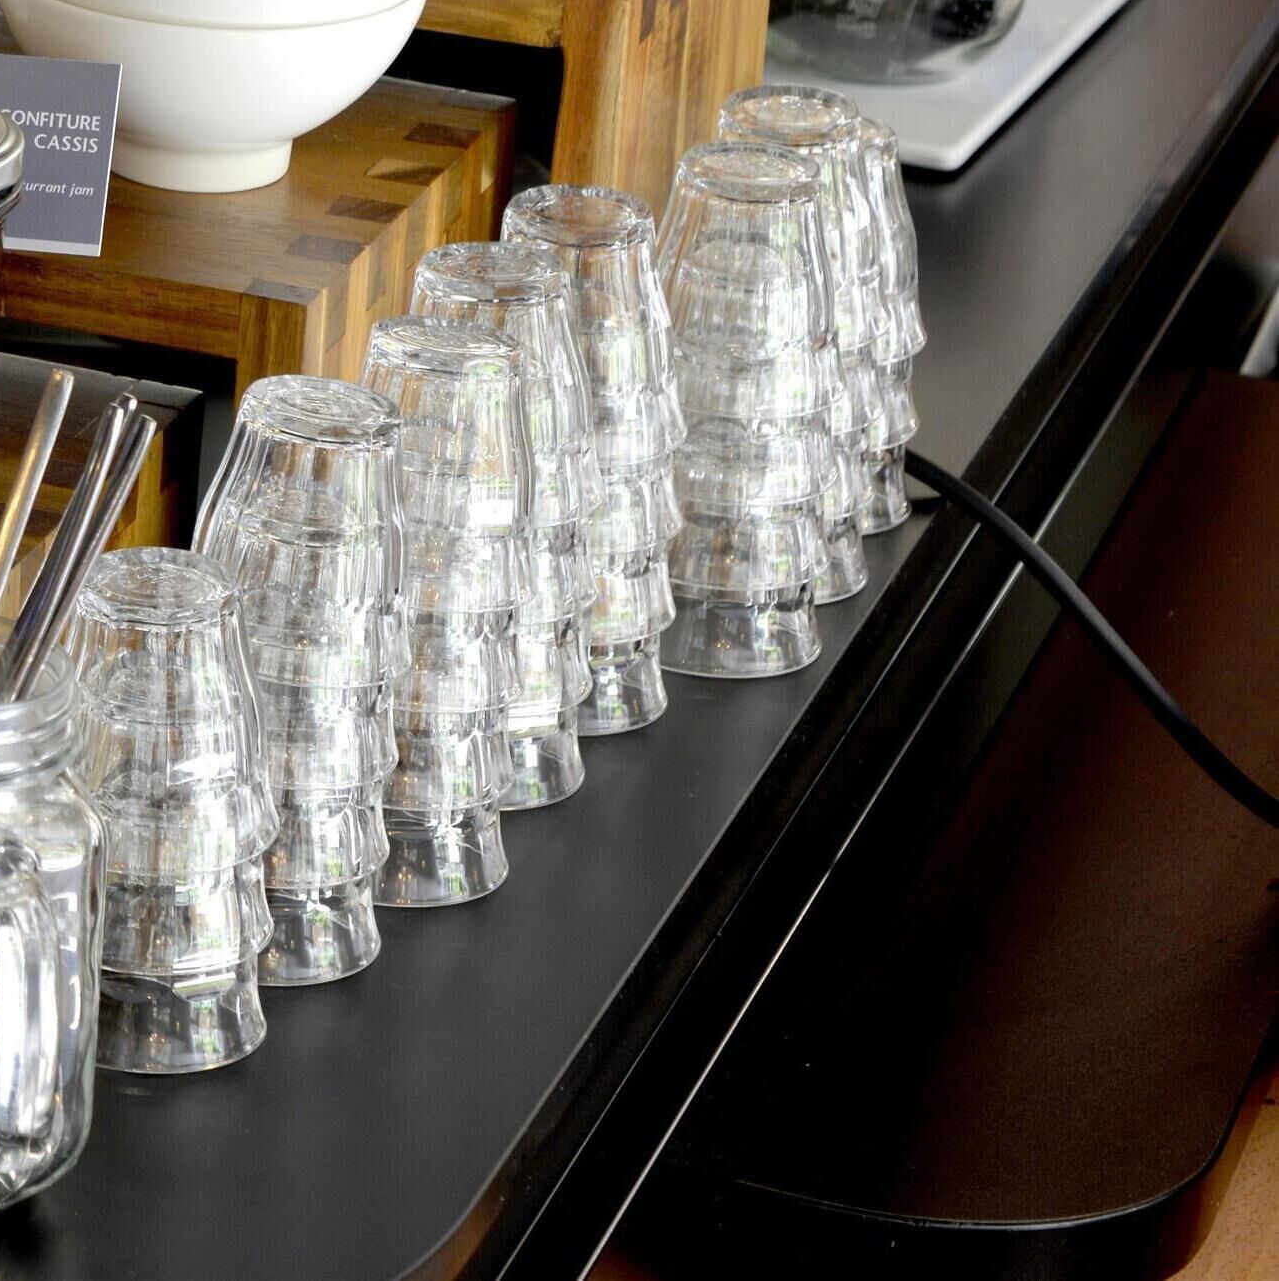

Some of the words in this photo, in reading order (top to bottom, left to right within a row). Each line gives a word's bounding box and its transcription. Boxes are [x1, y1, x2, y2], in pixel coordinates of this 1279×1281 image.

[1, 109, 101, 131] ONFITURE
[34, 134, 98, 153] CASSIS
[69, 182, 94, 198] jam
